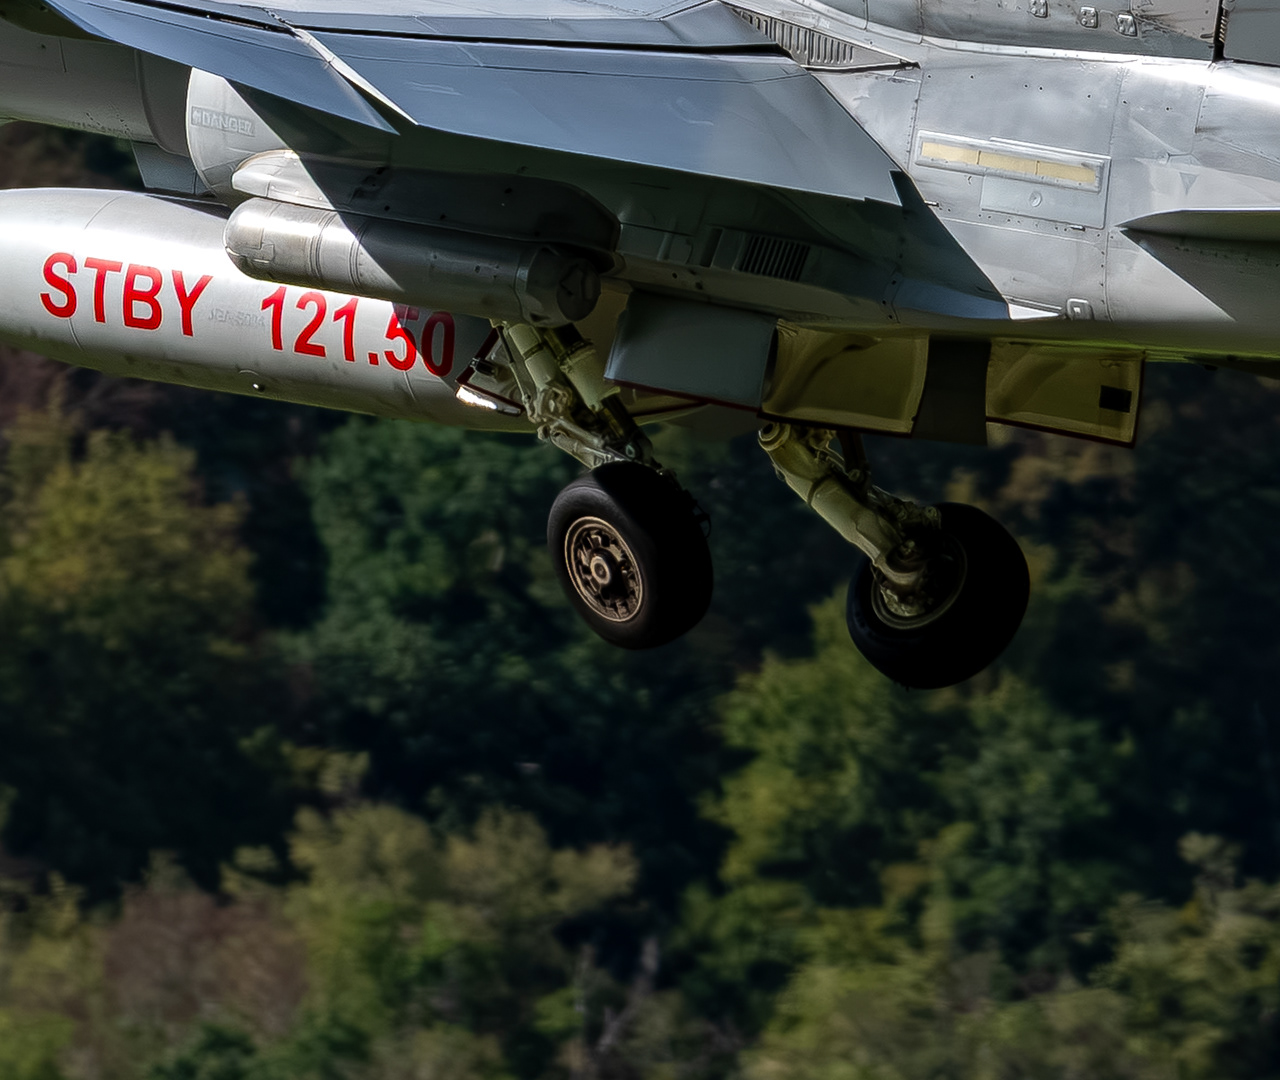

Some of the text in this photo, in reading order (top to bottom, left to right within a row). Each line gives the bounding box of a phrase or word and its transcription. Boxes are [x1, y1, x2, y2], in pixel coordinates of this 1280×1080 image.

[202, 110, 254, 135] DANGER
[40, 252, 455, 377] STBY 121.50
